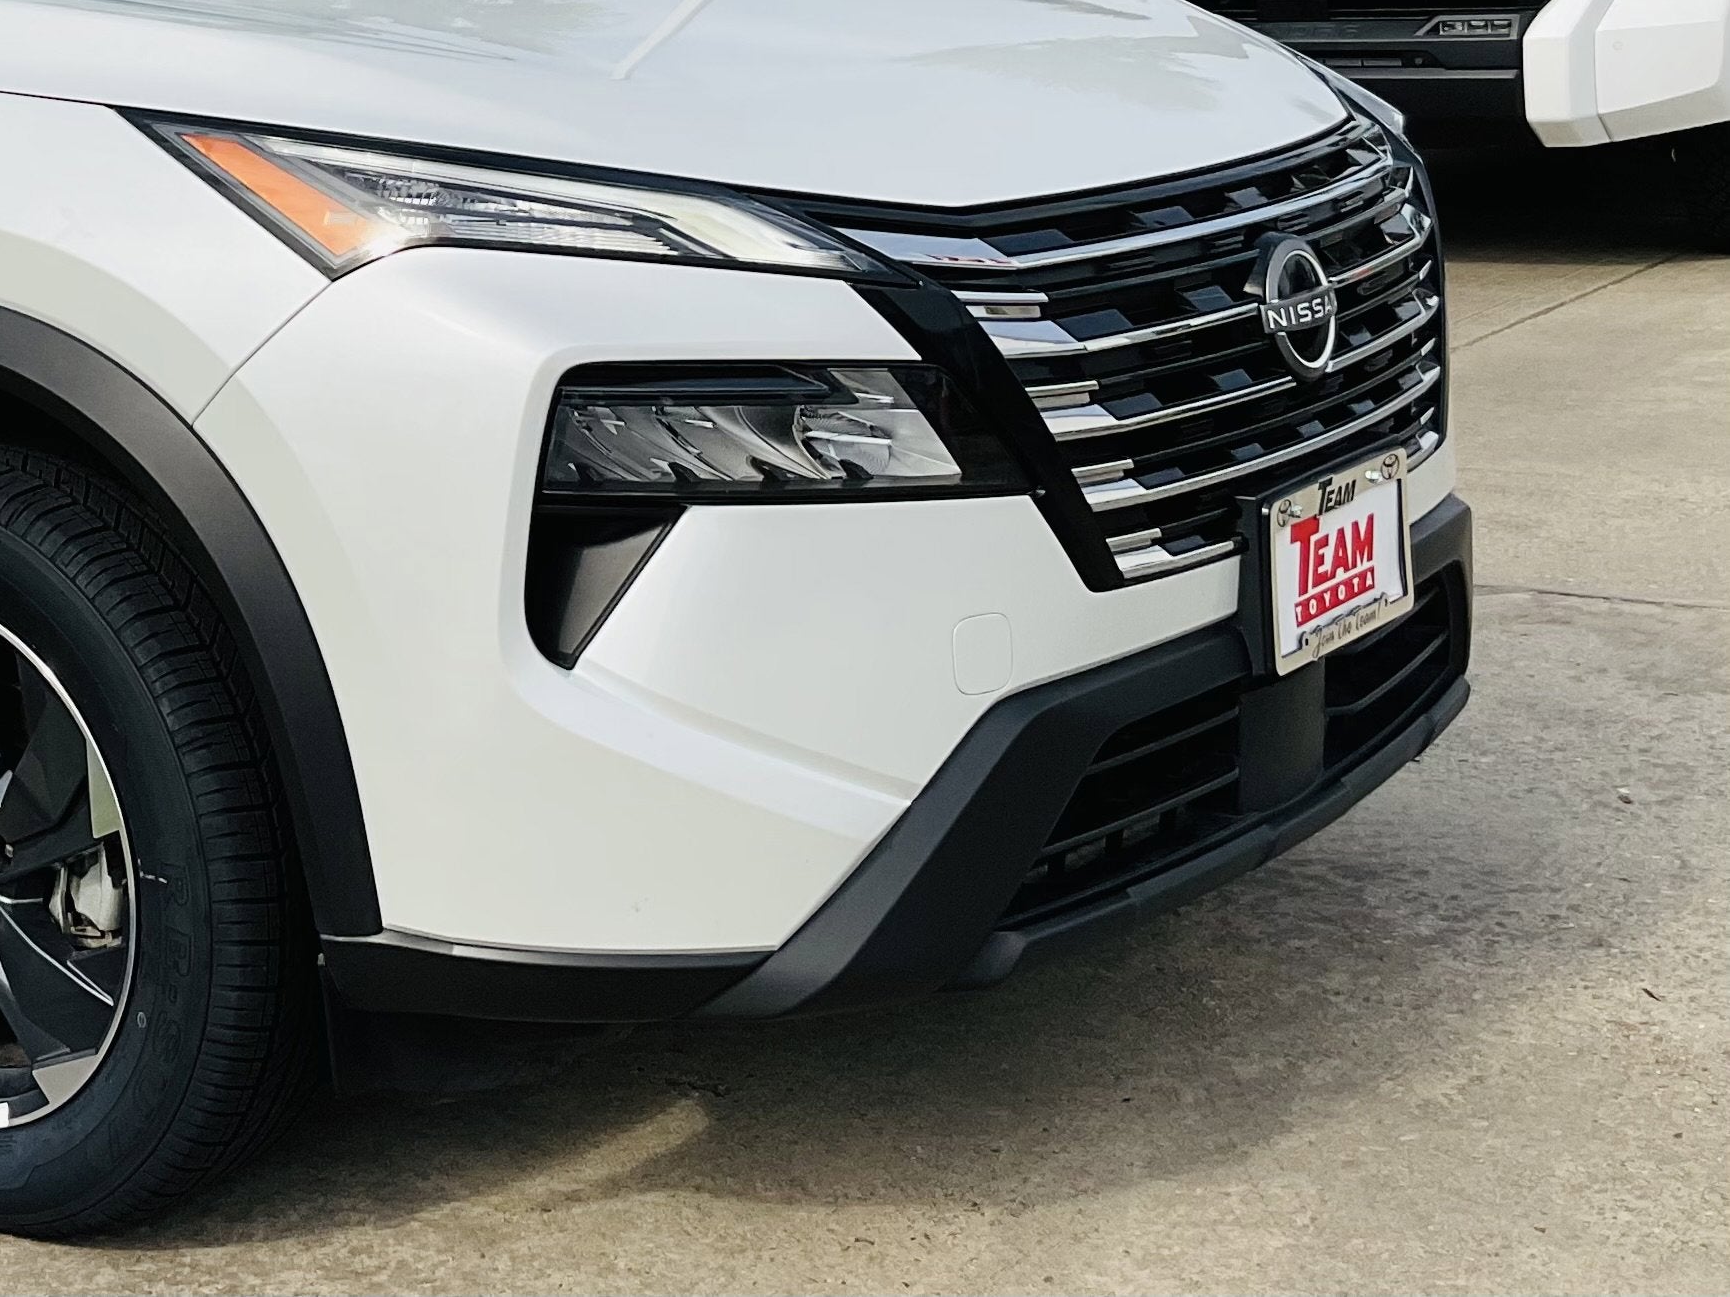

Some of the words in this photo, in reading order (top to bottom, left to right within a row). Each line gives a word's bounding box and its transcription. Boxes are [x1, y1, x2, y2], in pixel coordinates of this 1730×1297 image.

[1267, 295, 1334, 329] NISSA
[1317, 476, 1357, 517] TEAM
[1290, 512, 1375, 598] TEAM
[1295, 570, 1375, 623] TOYOTA
